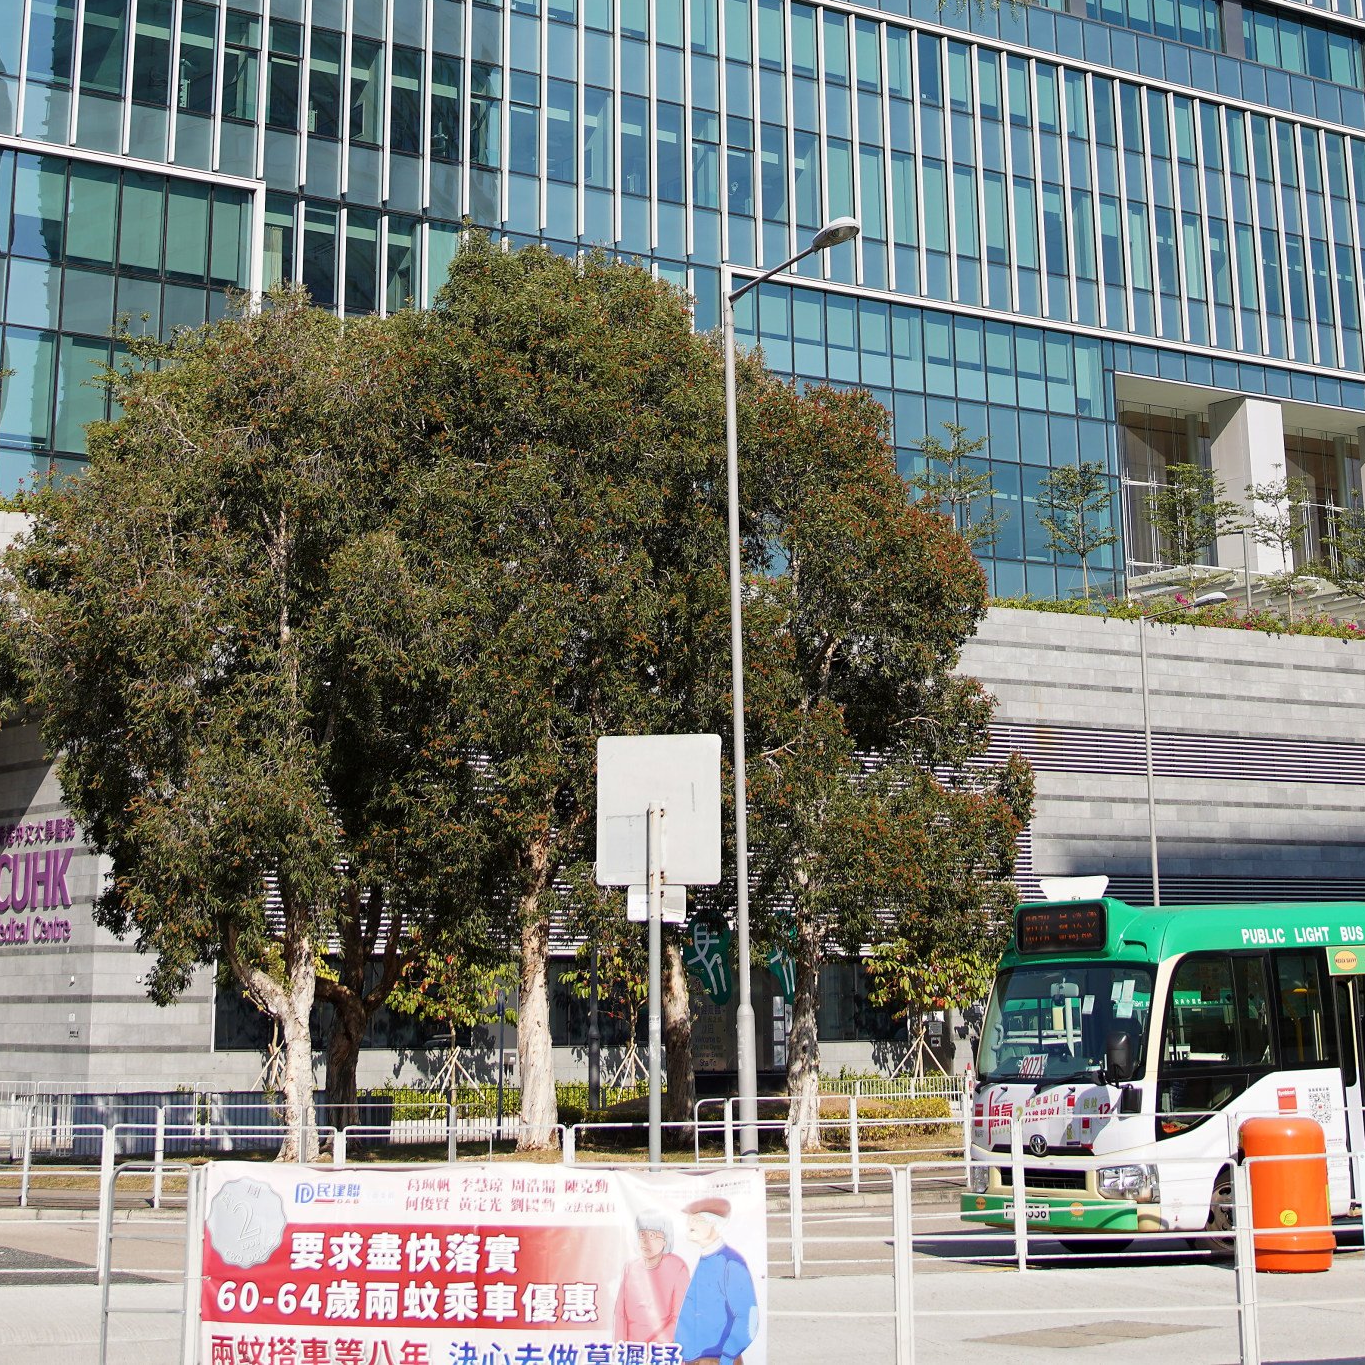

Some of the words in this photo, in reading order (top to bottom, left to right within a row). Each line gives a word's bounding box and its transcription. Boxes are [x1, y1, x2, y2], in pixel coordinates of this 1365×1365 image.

[33, 915, 72, 941] Centre
[1241, 927, 1286, 944] PUBLIC
[1294, 926, 1330, 943] LIGHT
[1340, 925, 1364, 941] BUS
[316, 1183, 361, 1198] 民建聯
[290, 1231, 521, 1275] 要求盡快落實
[215, 1281, 599, 1324] 60-64歲兩蚊乘車優惠
[211, 1334, 429, 1365] 兩蚊搭車等八年
[447, 1340, 683, 1365] 決心去做莫遲疑
